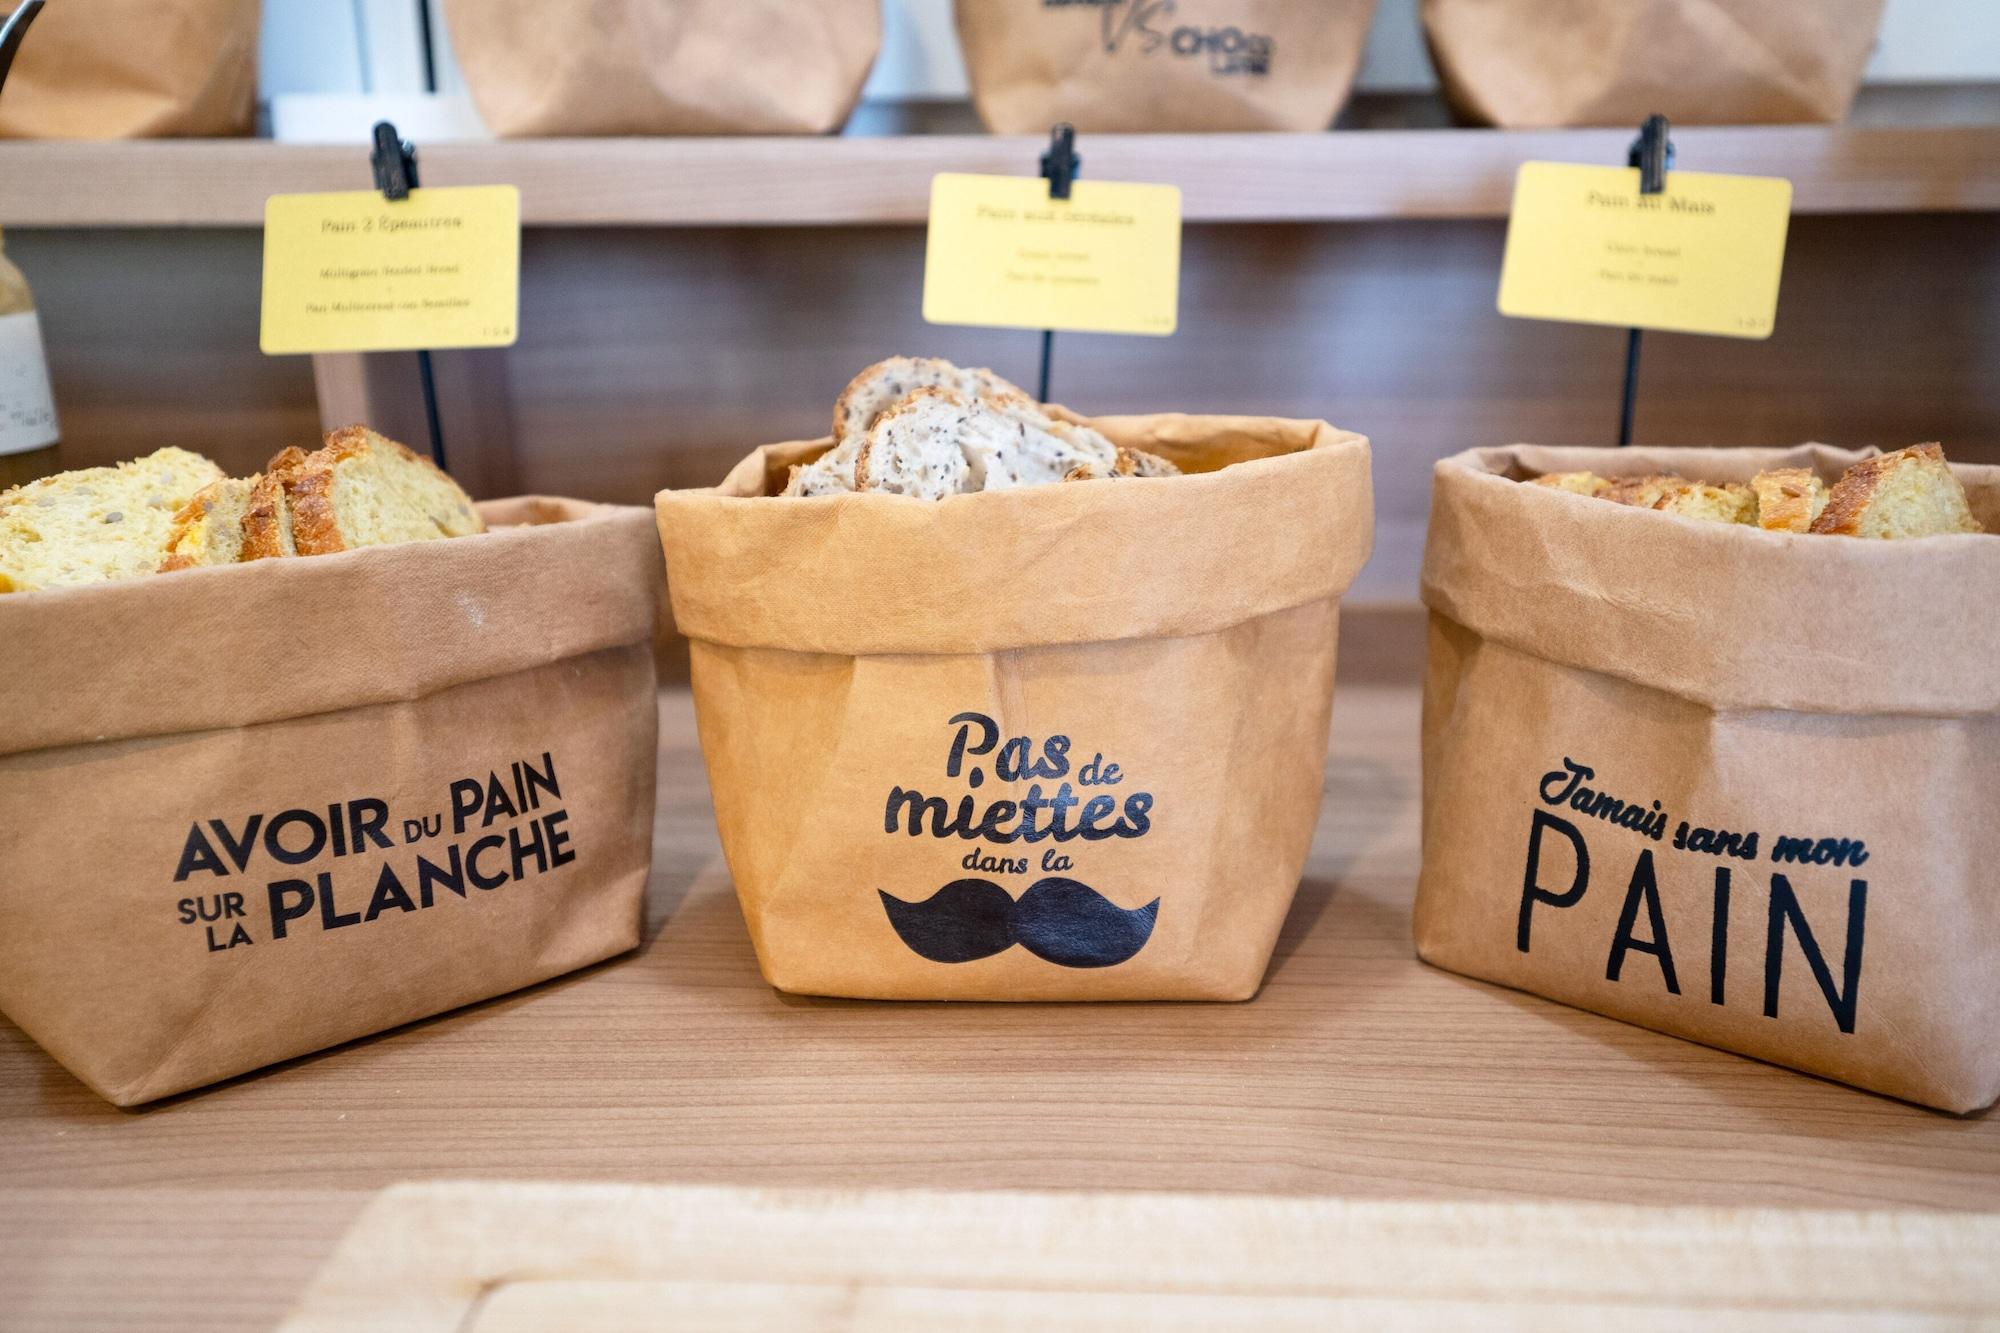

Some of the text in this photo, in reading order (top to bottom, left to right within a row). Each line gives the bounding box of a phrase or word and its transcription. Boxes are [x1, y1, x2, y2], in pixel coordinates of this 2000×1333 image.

[321, 217, 356, 233] Pain
[362, 217, 374, 232] 2
[1587, 192, 1629, 207] Pain
[947, 712, 1124, 786] Pas de
[173, 752, 561, 882] AVOIR DU PAIN
[884, 768, 1153, 844] miettes
[1540, 756, 1870, 867] Jamais sans mon
[177, 809, 576, 952] SUR LA PLANCHE
[962, 847, 1074, 874] dans la
[1517, 808, 1868, 1034] PAIN
